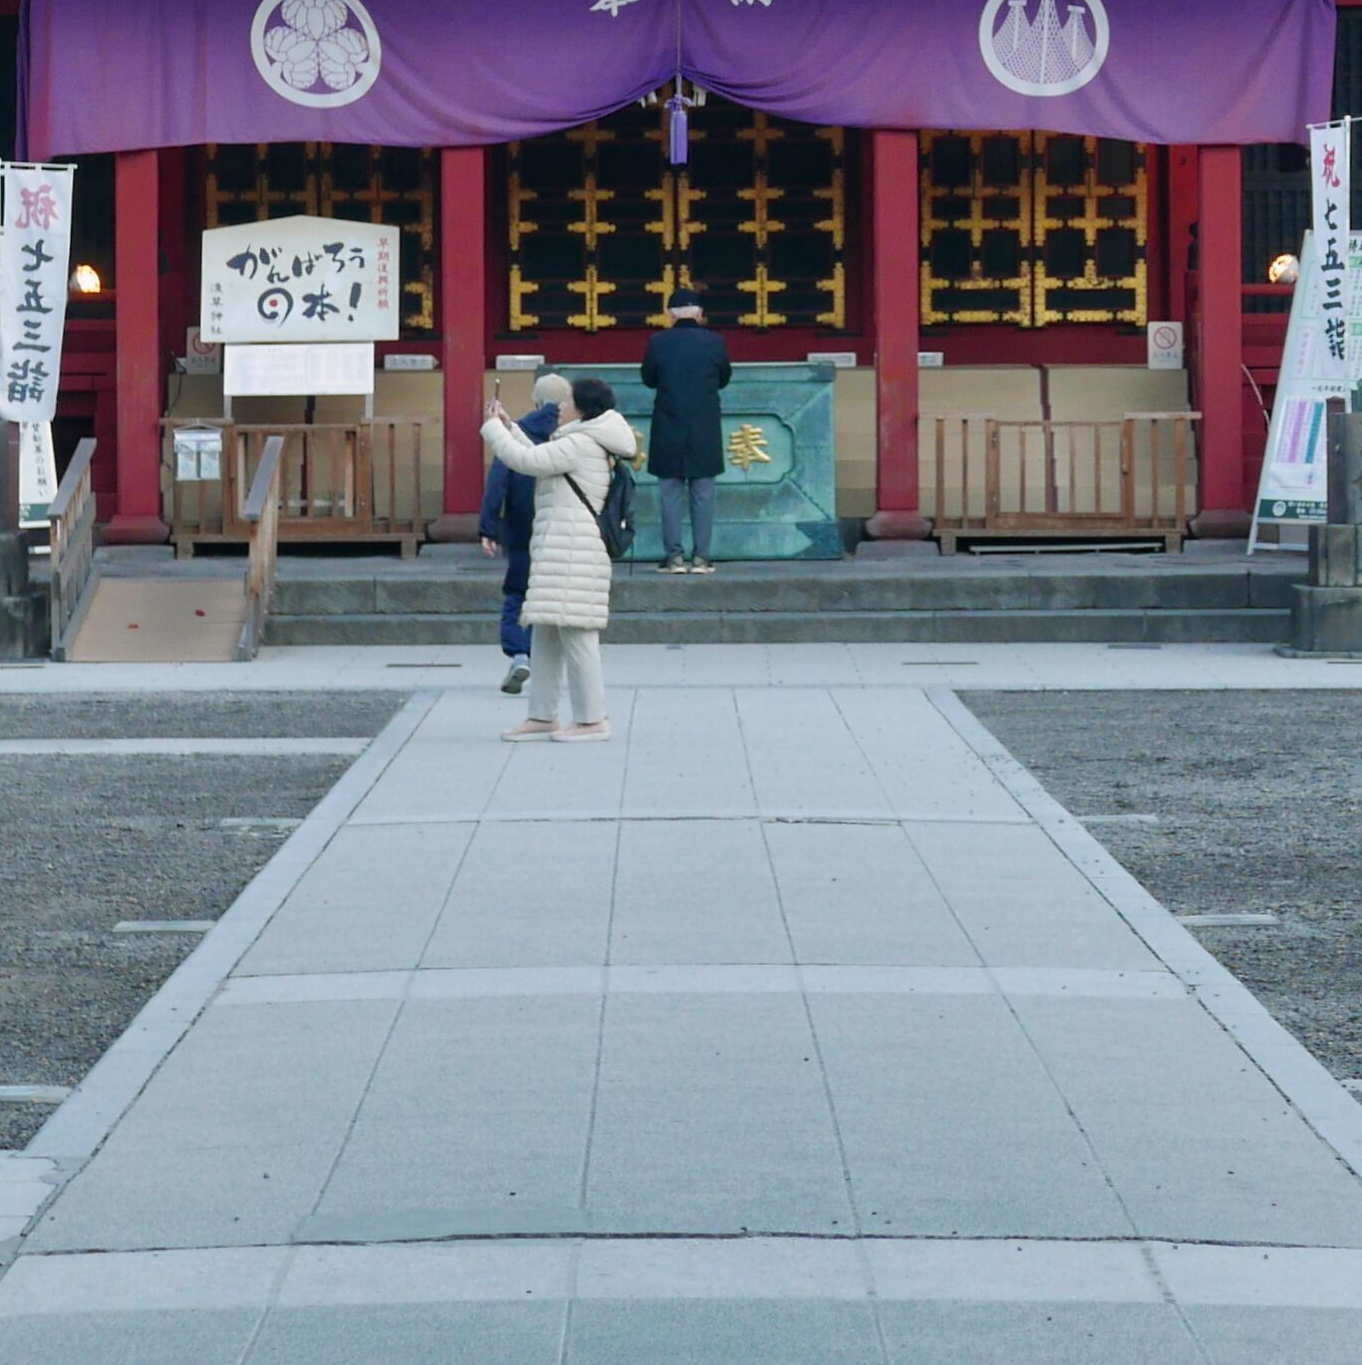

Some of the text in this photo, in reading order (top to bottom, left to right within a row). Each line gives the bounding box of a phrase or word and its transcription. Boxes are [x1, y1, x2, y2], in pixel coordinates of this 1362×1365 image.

[226, 242, 366, 284] がんばろう
